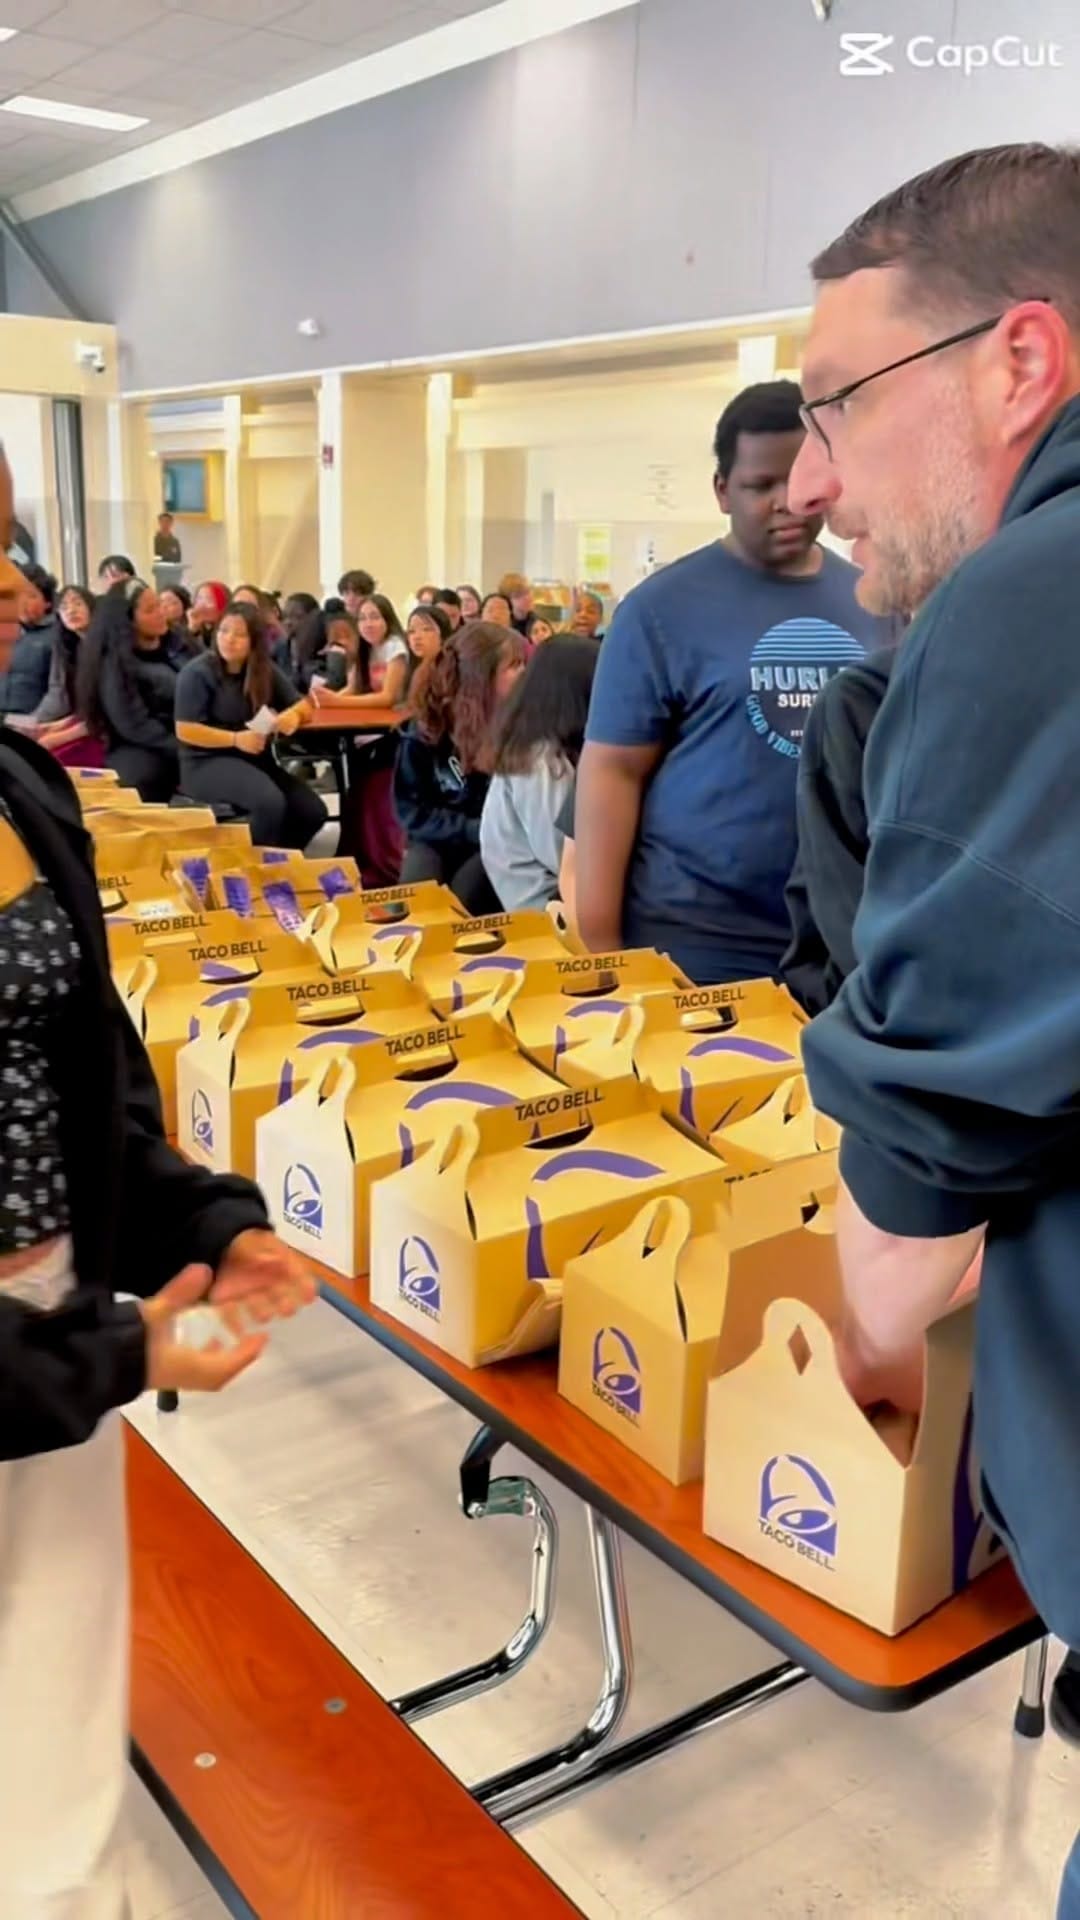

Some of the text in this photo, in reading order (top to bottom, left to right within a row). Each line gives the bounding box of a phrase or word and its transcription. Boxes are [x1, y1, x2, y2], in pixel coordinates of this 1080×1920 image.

[750, 666, 849, 691] HURL
[360, 887, 416, 904] TACO BELL
[132, 914, 210, 935] TACO BELL
[452, 915, 514, 934] TACO BELL
[188, 940, 268, 961] TACO BELL
[556, 955, 628, 974] TACO BELL
[287, 978, 374, 1001] TACO BELL
[673, 987, 746, 1009] TACO BELL
[385, 1025, 465, 1056] TACO BELL
[515, 1087, 606, 1121] TACO BELL
[758, 1519, 837, 1573] TACO BELL
